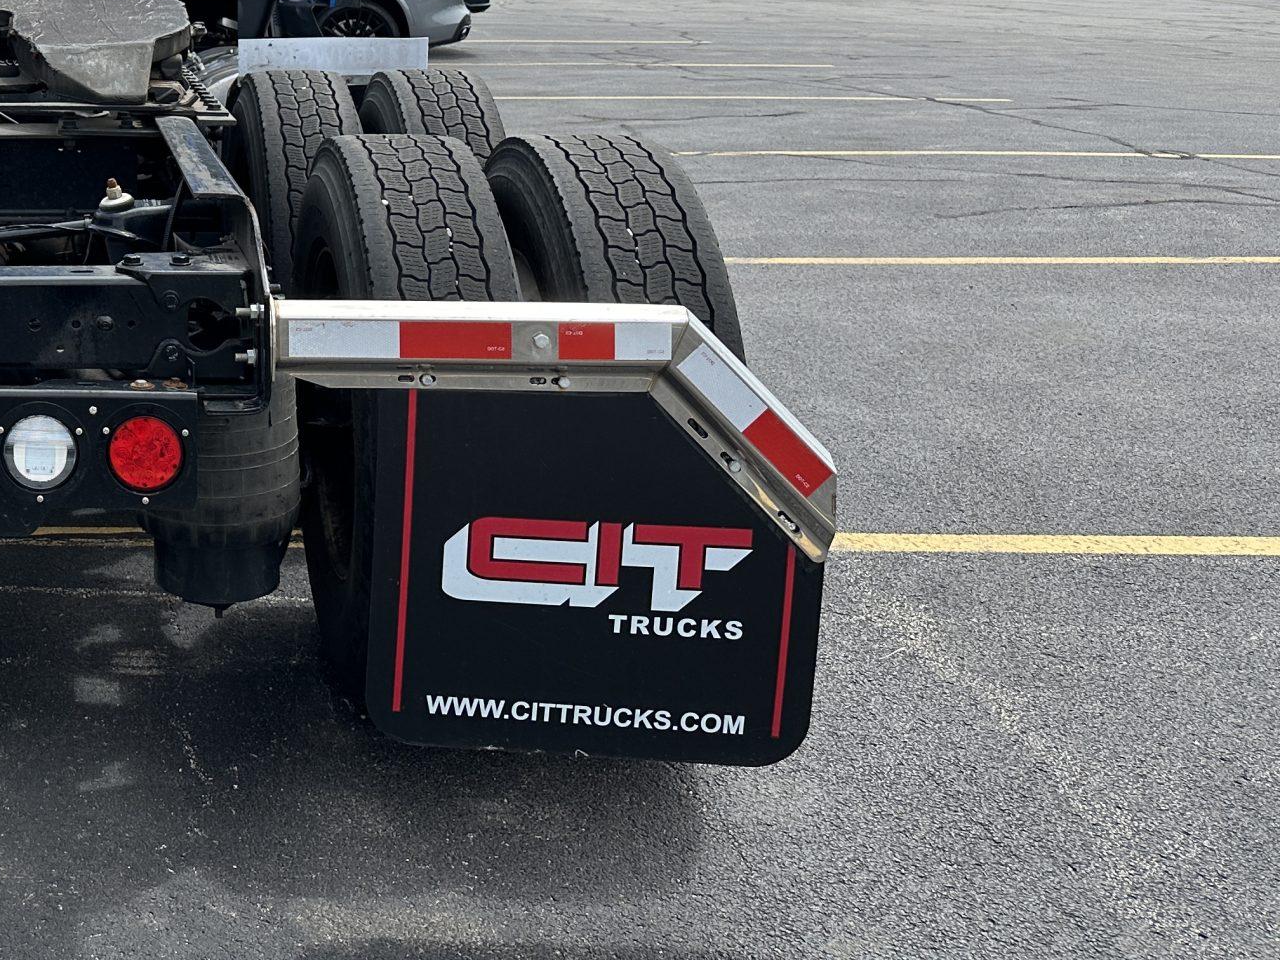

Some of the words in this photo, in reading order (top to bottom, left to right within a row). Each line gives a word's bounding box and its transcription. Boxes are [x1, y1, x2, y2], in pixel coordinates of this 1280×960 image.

[442, 517, 753, 612] CIT
[608, 614, 743, 640] TRUCKS
[426, 694, 746, 735] WWW.CITTRUCKS.COM
